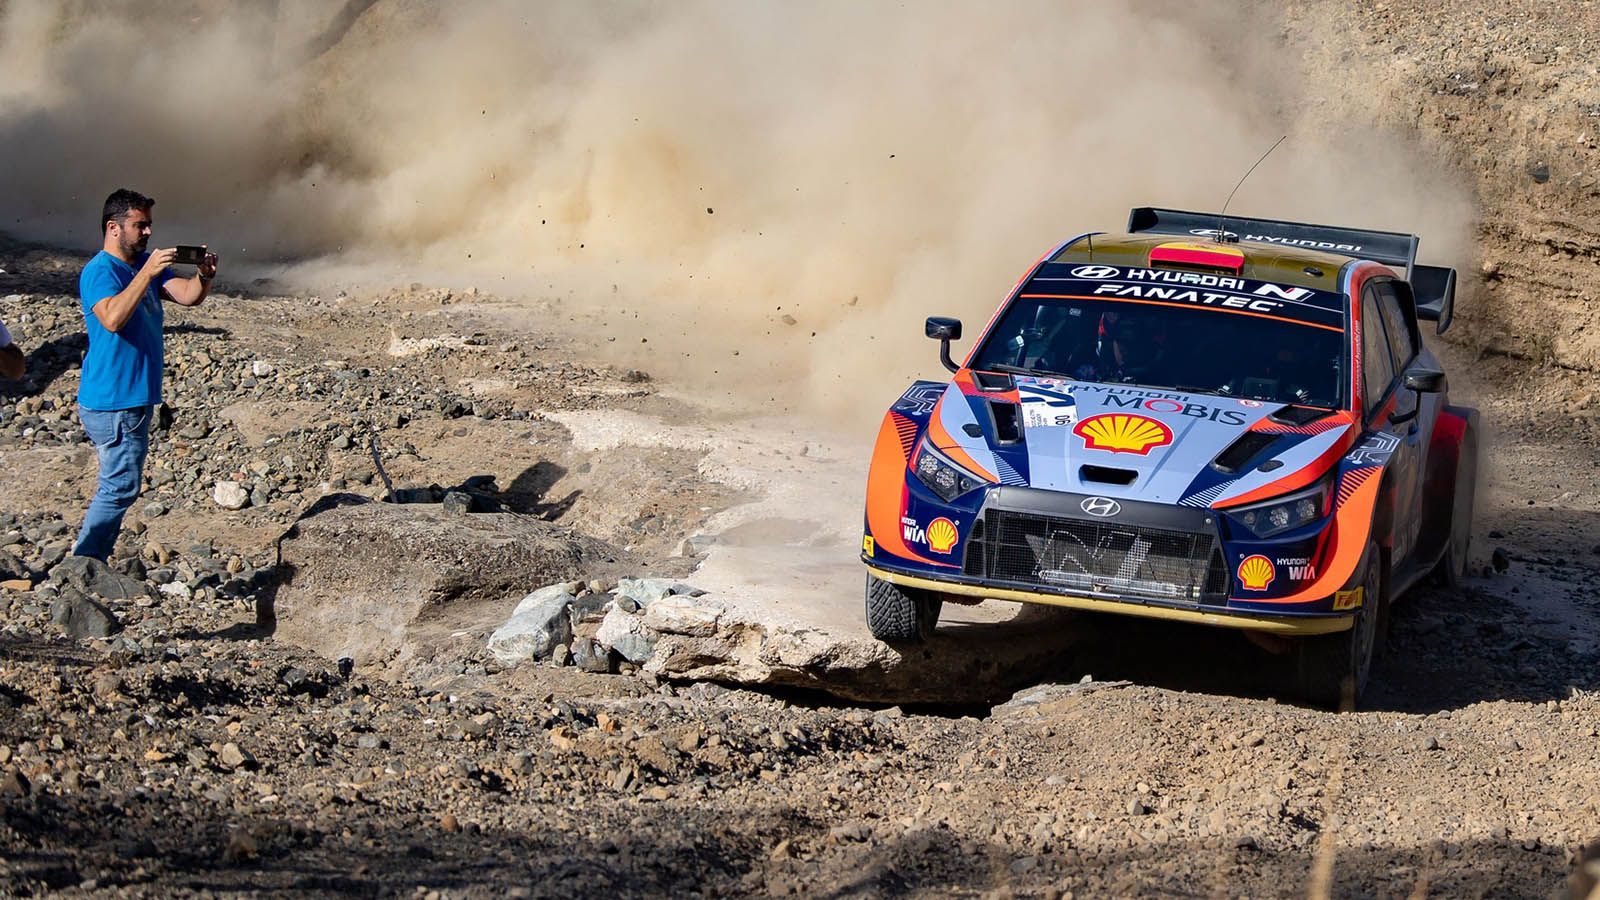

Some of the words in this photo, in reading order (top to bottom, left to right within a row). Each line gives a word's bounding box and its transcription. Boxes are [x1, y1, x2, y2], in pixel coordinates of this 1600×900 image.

[1244, 234, 1362, 251] HYUNDAI
[1126, 268, 1245, 290] HYUNDAI
[1094, 284, 1279, 312] FANATEC
[1072, 385, 1190, 402] HYUNDAI
[1101, 394, 1247, 426] MOBIS
[903, 525, 927, 545] WIA
[1276, 557, 1307, 566] HYUNDAI
[1288, 563, 1316, 580] WIA
